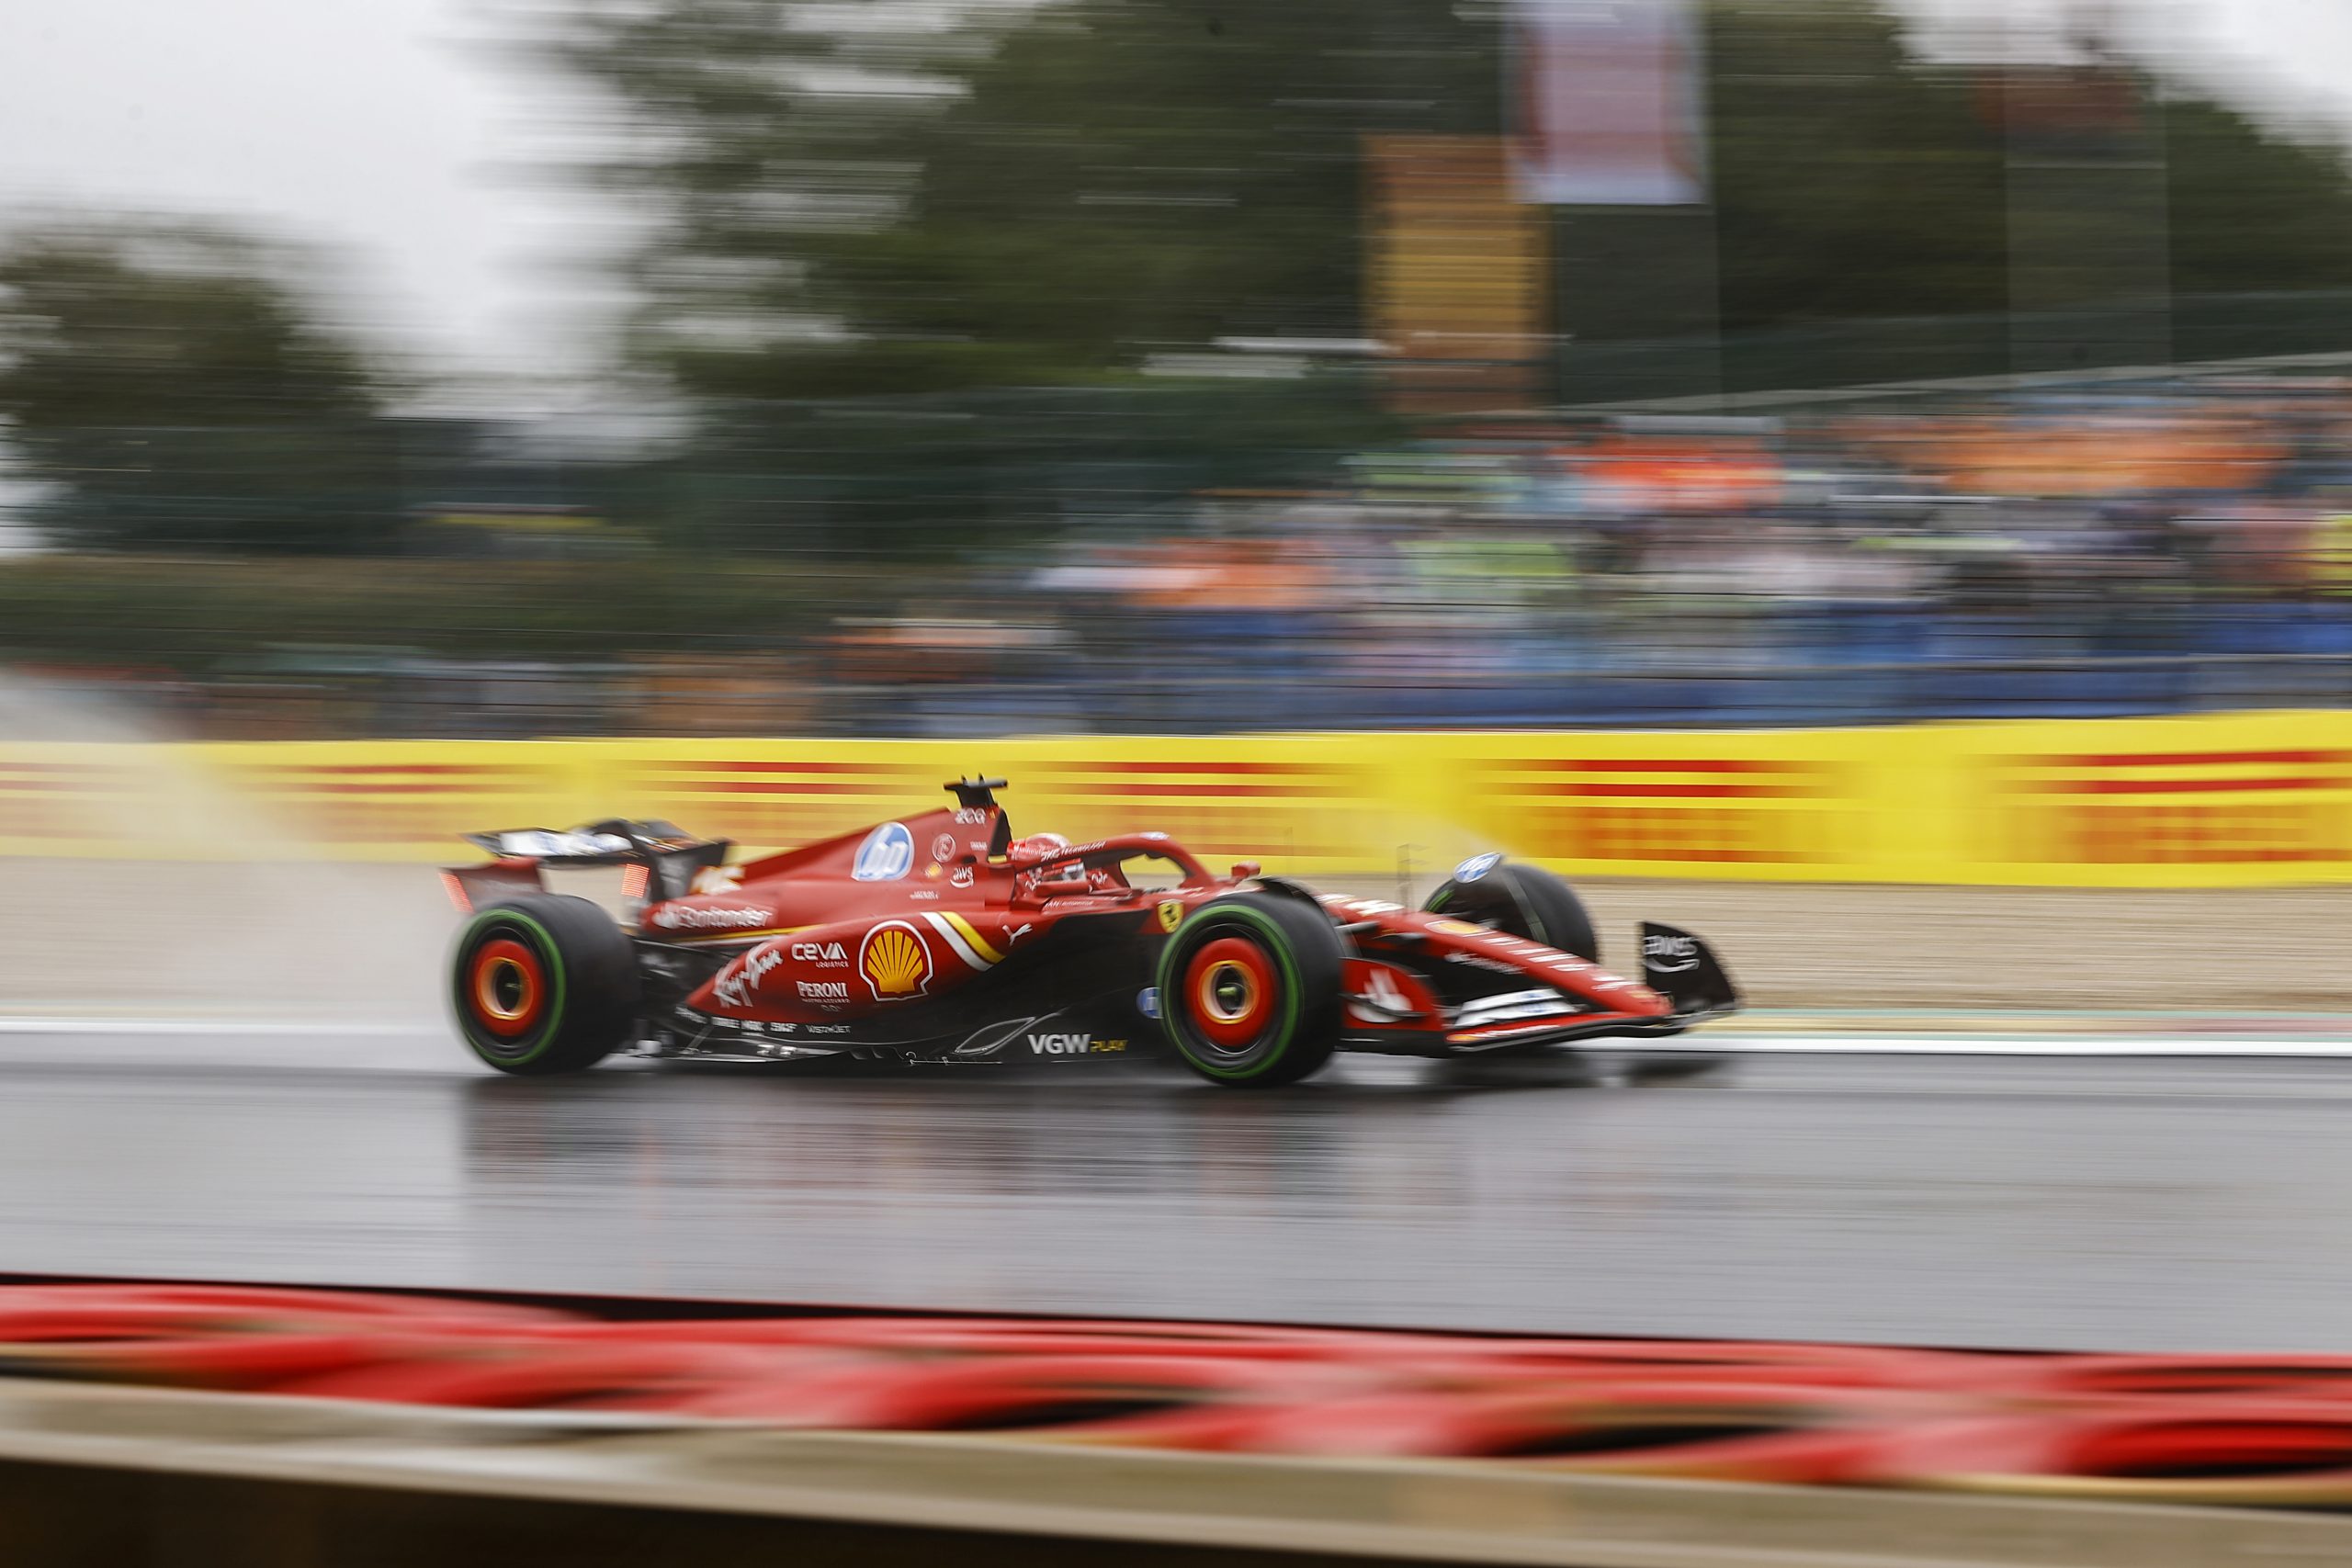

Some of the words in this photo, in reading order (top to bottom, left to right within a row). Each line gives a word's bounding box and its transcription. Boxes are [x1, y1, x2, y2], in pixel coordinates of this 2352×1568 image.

[796, 980, 848, 998] PERONI
[1027, 1033, 1091, 1055] VGW
[1091, 1040, 1127, 1052] PLAY
